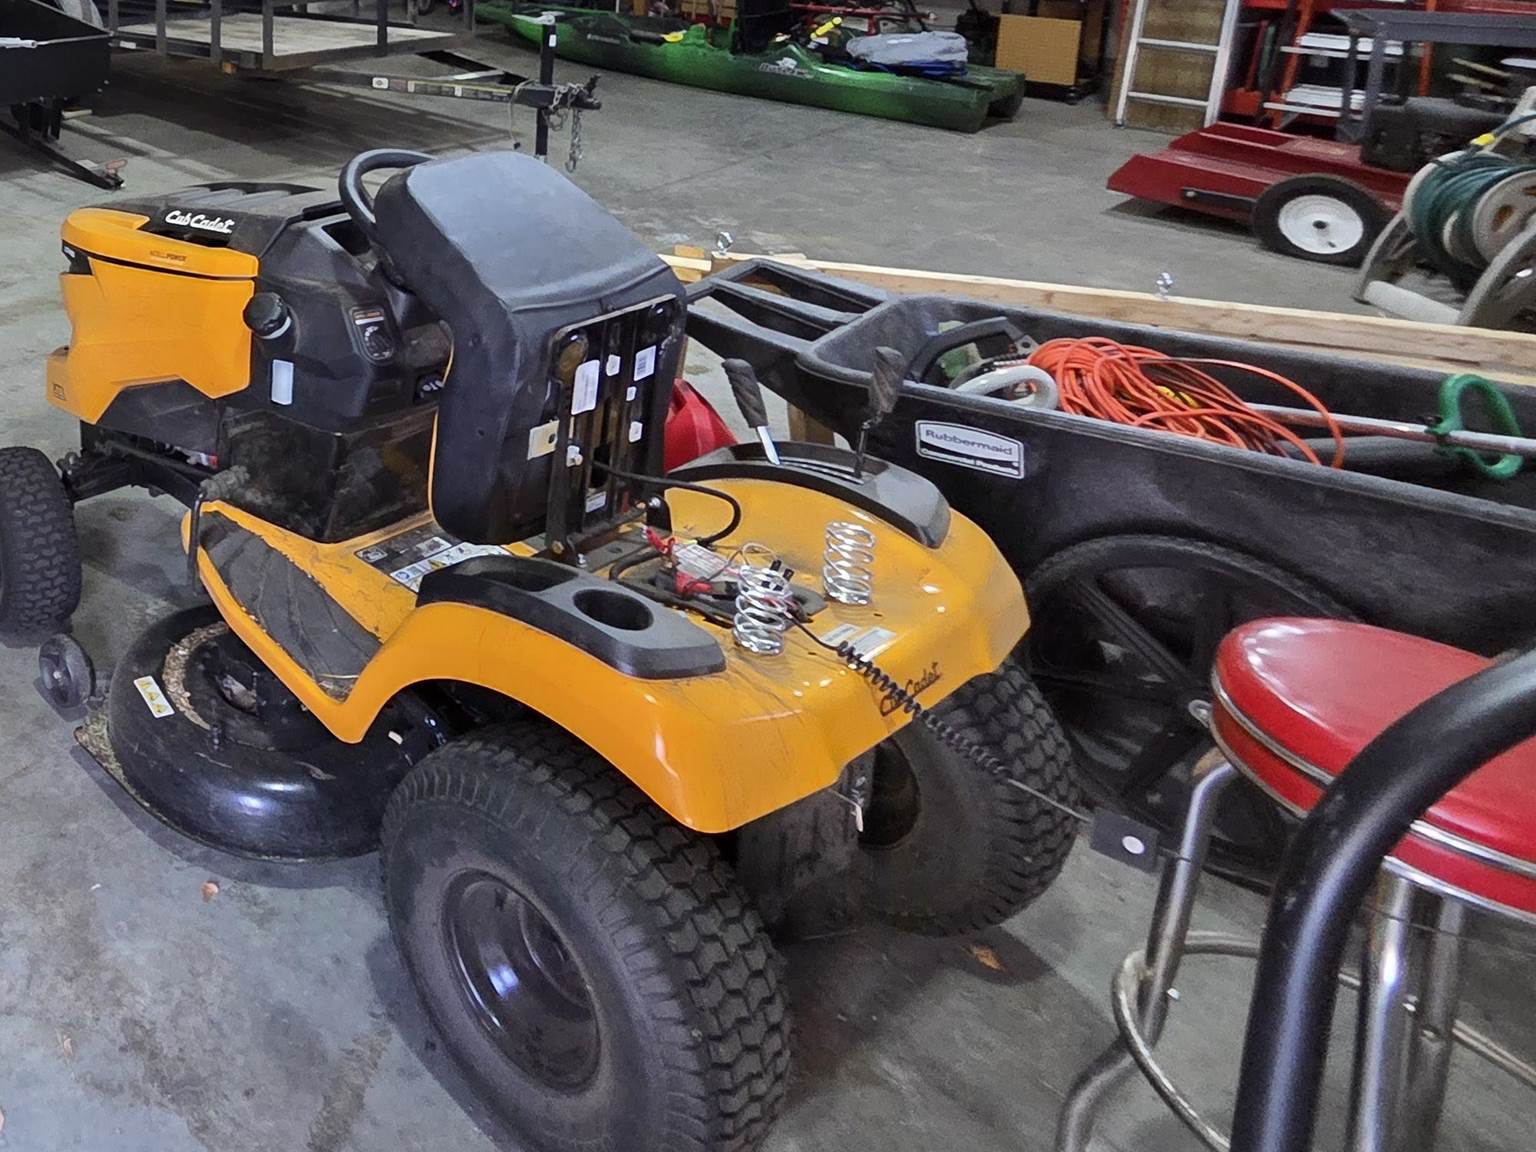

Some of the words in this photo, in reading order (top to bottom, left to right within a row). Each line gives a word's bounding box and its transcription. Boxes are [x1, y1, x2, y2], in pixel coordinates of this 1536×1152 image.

[165, 210, 192, 225] Cub
[190, 214, 235, 234] Cadet
[925, 429, 1013, 456] Rubbermaid
